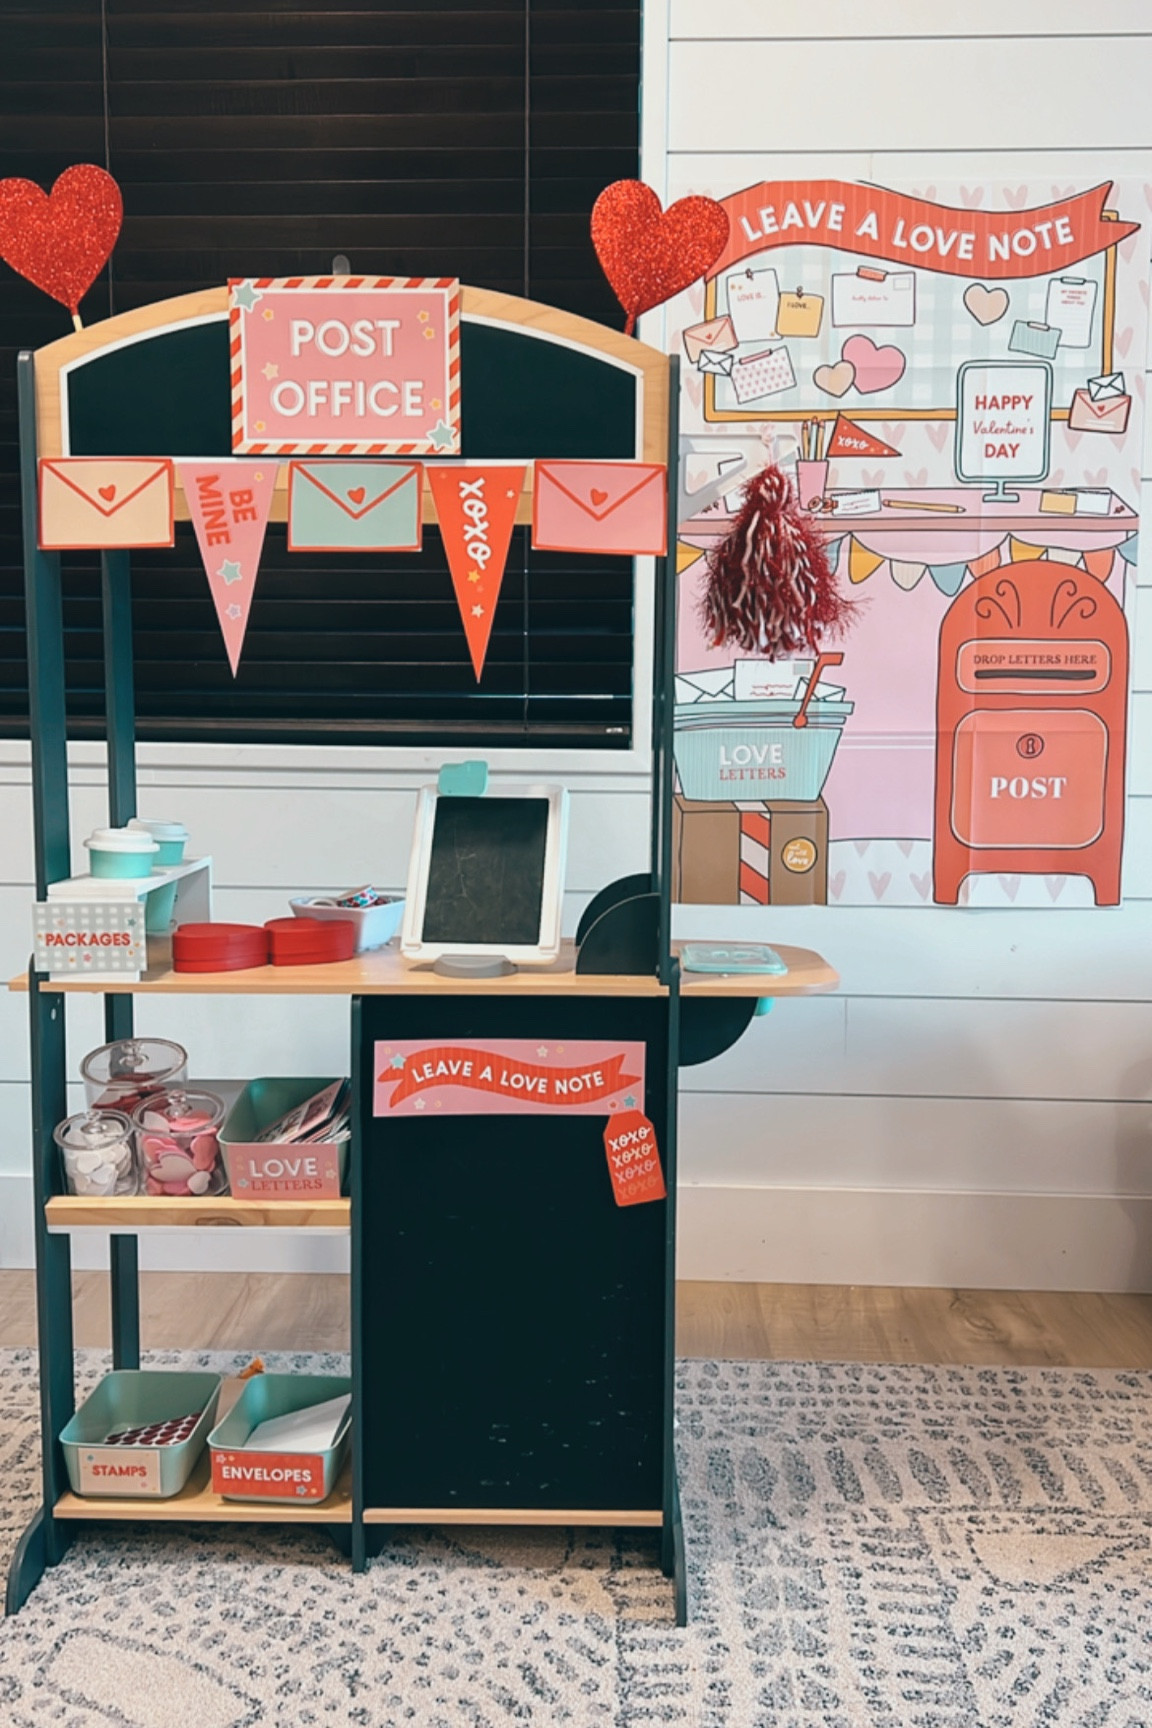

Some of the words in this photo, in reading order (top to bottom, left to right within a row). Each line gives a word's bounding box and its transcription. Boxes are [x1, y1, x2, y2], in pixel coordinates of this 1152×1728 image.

[740, 200, 846, 242] LEAVE
[856, 211, 879, 240] A
[892, 218, 975, 261] LOVE
[988, 216, 1075, 262] NOTE
[290, 319, 401, 358] POST
[270, 380, 425, 419] OFFICE
[975, 395, 1034, 410] HAPPY
[973, 418, 1034, 434] Valentine's
[984, 443, 1020, 458] DAY
[195, 474, 232, 547] MINE
[229, 487, 258, 524] BE
[973, 655, 1006, 665] DROP
[1008, 655, 1062, 664] LETTERS
[1064, 655, 1097, 664] HERE
[719, 744, 783, 766] LOVE
[719, 767, 786, 781] LETTERS
[990, 776, 1067, 799] POST
[45, 932, 131, 947] PACKAGES
[411, 1060, 473, 1083] LEAVE
[479, 1065, 493, 1082] A
[500, 1073, 548, 1094] LOVE
[554, 1070, 605, 1095] NOTE
[249, 1157, 318, 1178] LOVE
[250, 1178, 323, 1192] LETTERS
[91, 1464, 147, 1477] STAMPS
[221, 1465, 313, 1483] ENVELOPES
